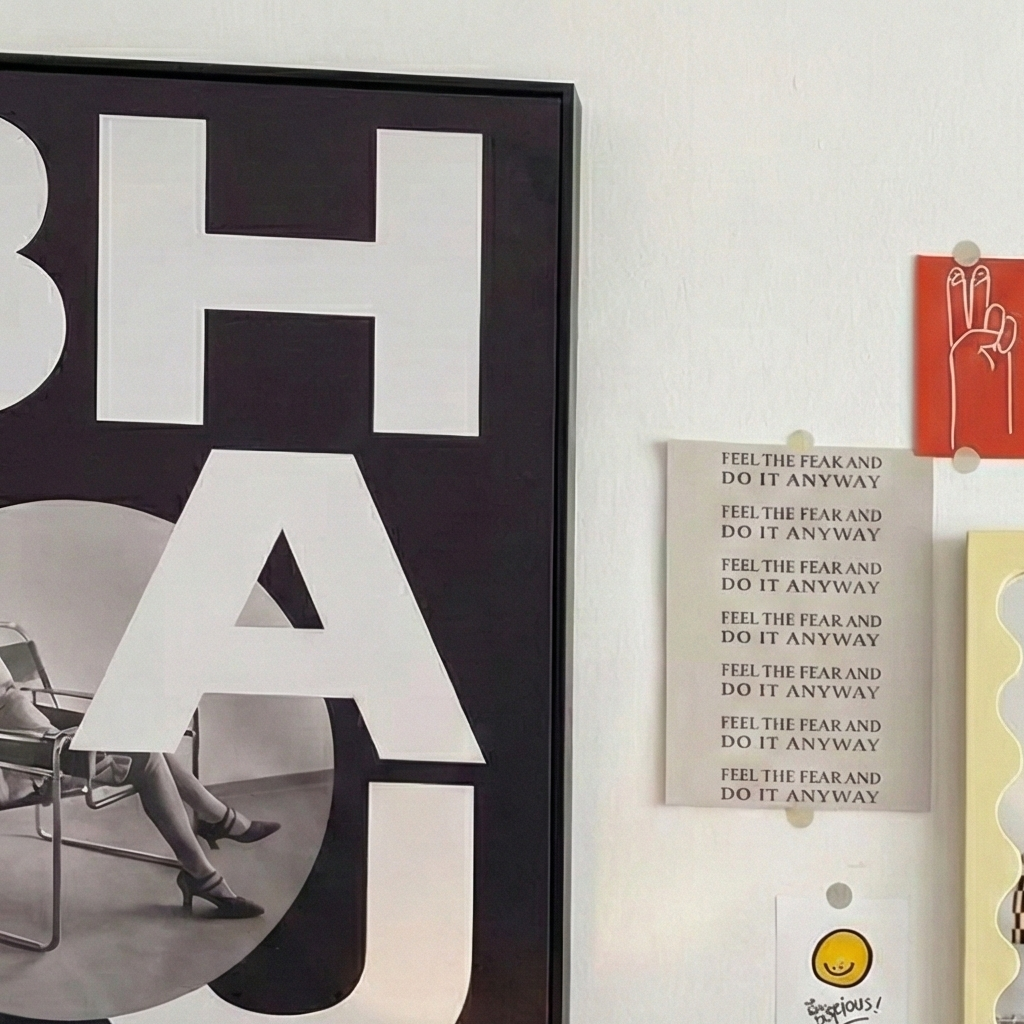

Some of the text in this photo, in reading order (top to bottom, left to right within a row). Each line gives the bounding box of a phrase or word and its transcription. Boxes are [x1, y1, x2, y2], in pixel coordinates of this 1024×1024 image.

[721, 451, 761, 467] FEEL
[761, 453, 796, 468] THE
[845, 455, 883, 470] AND
[721, 470, 881, 489] DO IT ANYWAY
[721, 504, 883, 523] FEEL THE FEAR AND
[721, 524, 881, 542] DO IT ANYWAY
[721, 557, 883, 576] FEEL THE FEAR AND
[721, 576, 881, 595] DO IT ANYWAY
[721, 610, 883, 628] FEEL THE FEAR AND
[720, 629, 880, 648] DO IT ANYWAY
[721, 662, 882, 681] FEEL THE FEAR AND
[721, 681, 880, 700] DO IT ANYWAY
[720, 715, 882, 733] FEEL THE FEAR AND
[721, 734, 880, 752] DO IT ANYWAY
[720, 767, 882, 786] FEEL THE FEAR AND
[720, 786, 880, 804] DO IT ANYWAY
